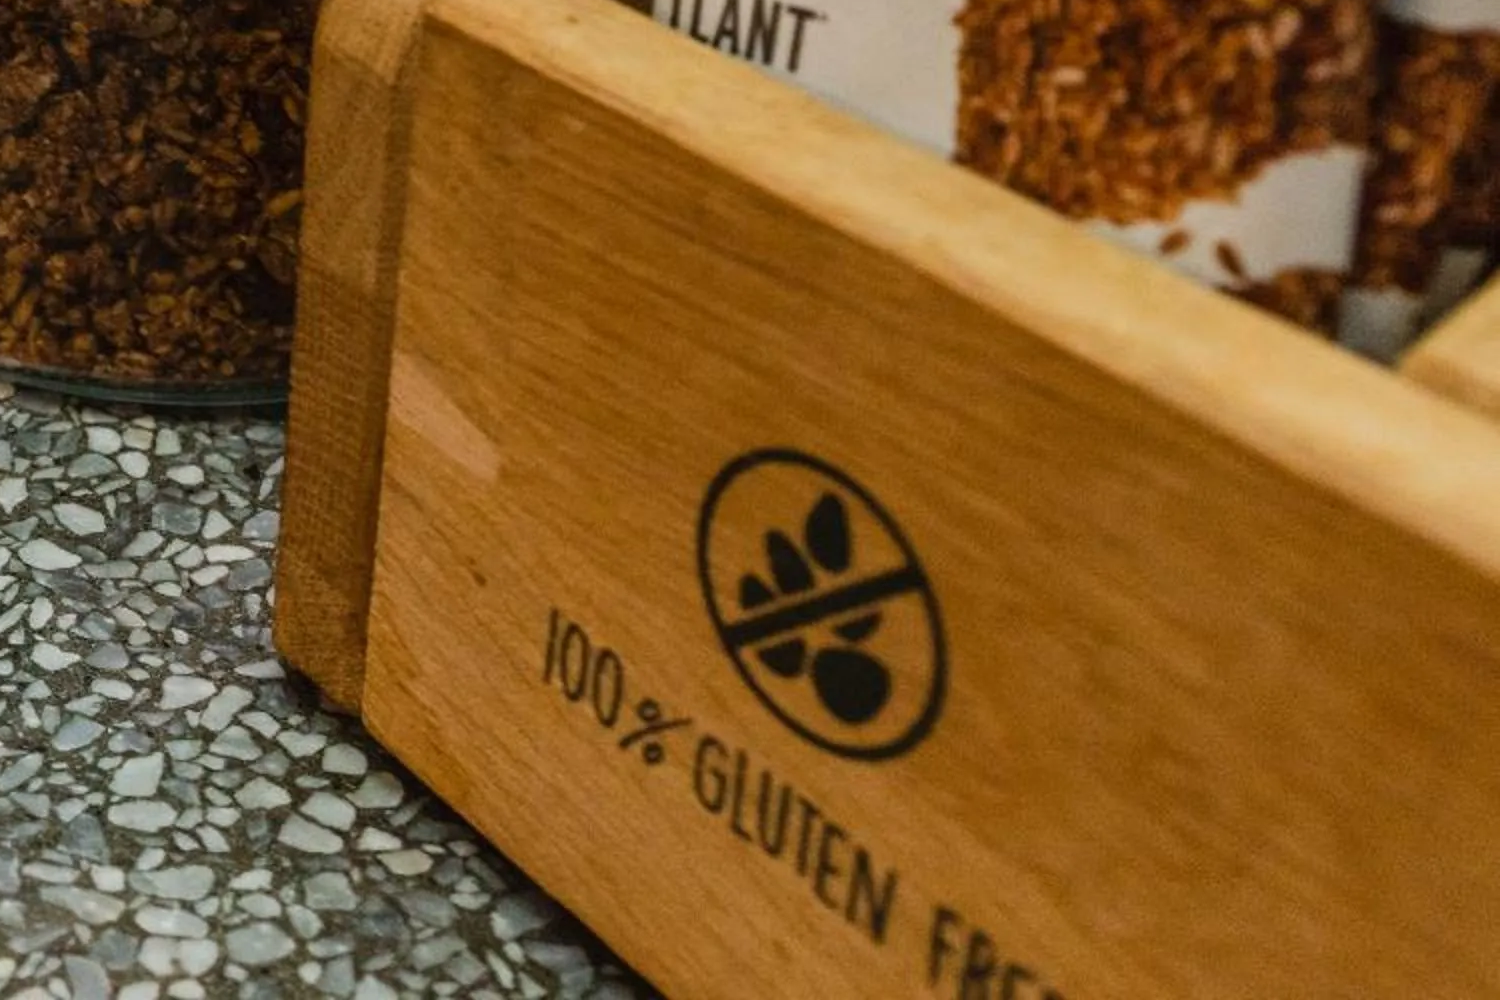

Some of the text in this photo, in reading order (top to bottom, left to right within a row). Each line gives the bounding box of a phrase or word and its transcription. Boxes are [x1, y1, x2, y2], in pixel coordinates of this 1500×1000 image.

[543, 606, 1067, 1000] 100% GLUTEN FR
